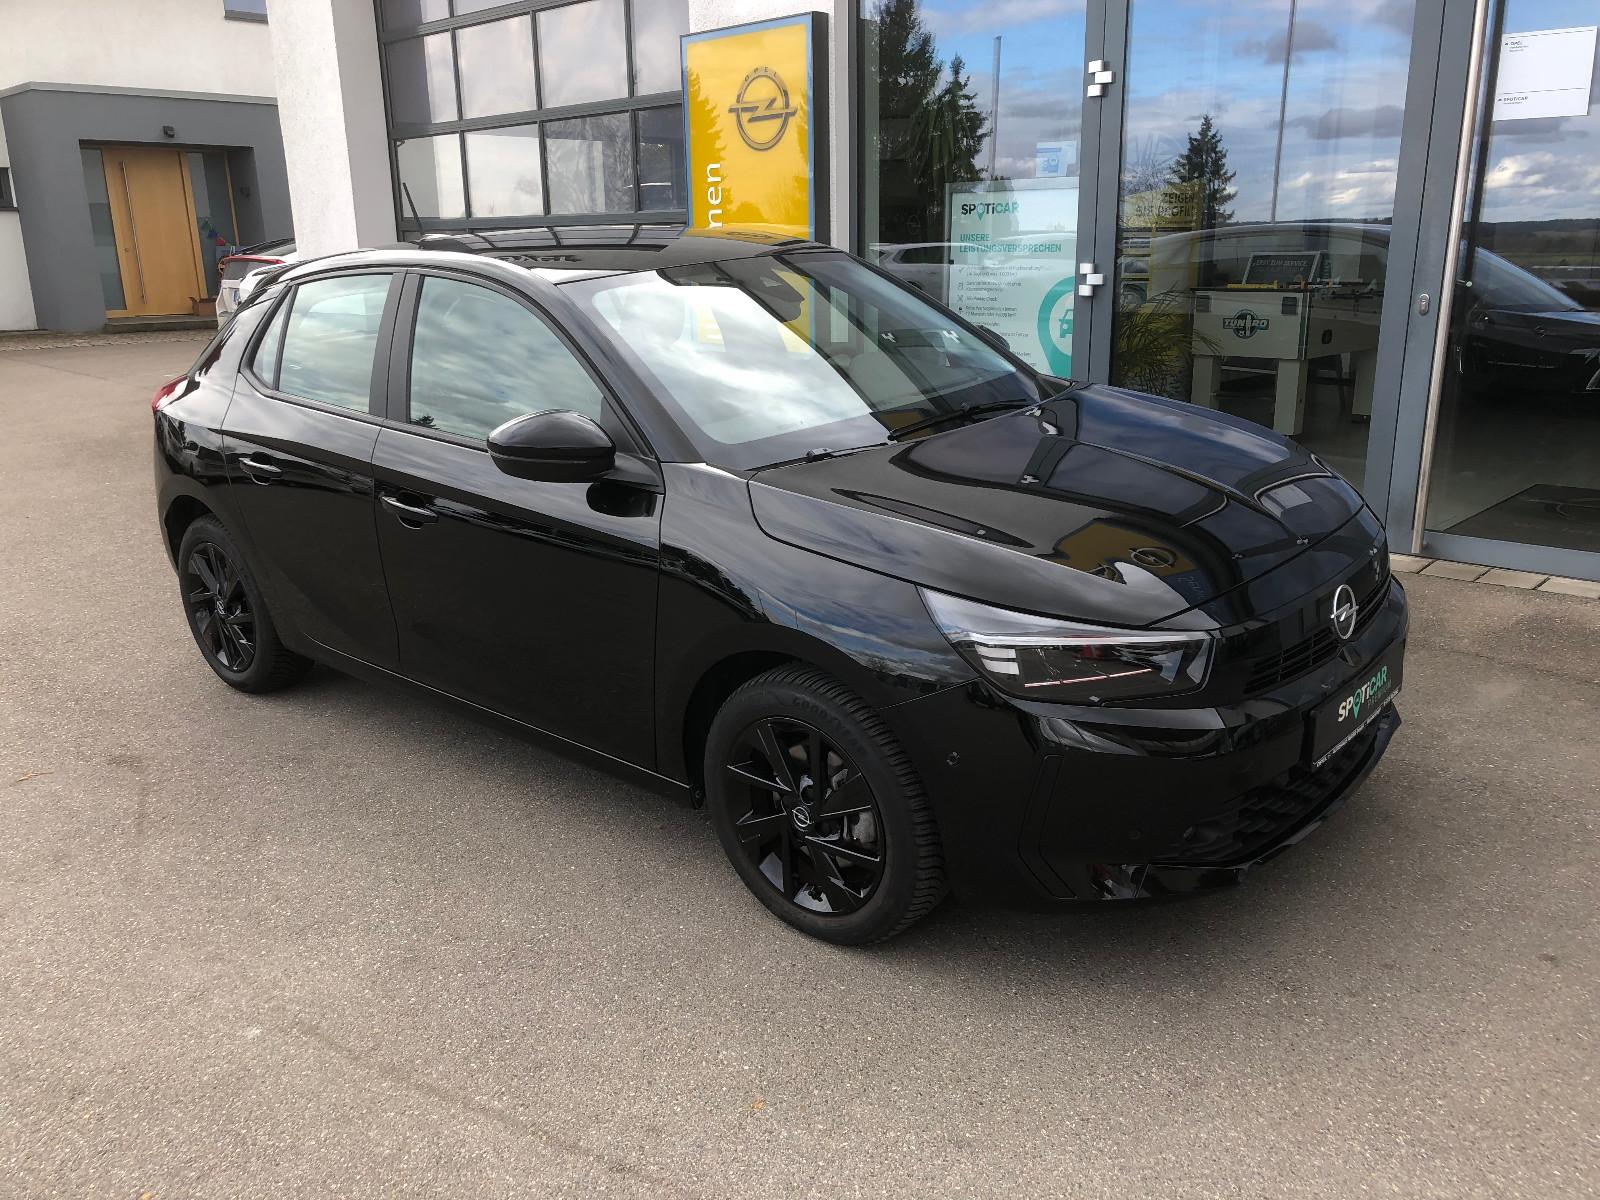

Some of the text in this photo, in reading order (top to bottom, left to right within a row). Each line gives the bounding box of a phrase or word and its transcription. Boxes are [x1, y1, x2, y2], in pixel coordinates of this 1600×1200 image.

[744, 66, 778, 81] OPEL
[706, 162, 724, 229] nen
[960, 233, 990, 242] UNSERE
[959, 243, 1062, 254] LEISTUNGSVERSPRECHEN
[1337, 665, 1388, 721] SPOTiCAR
